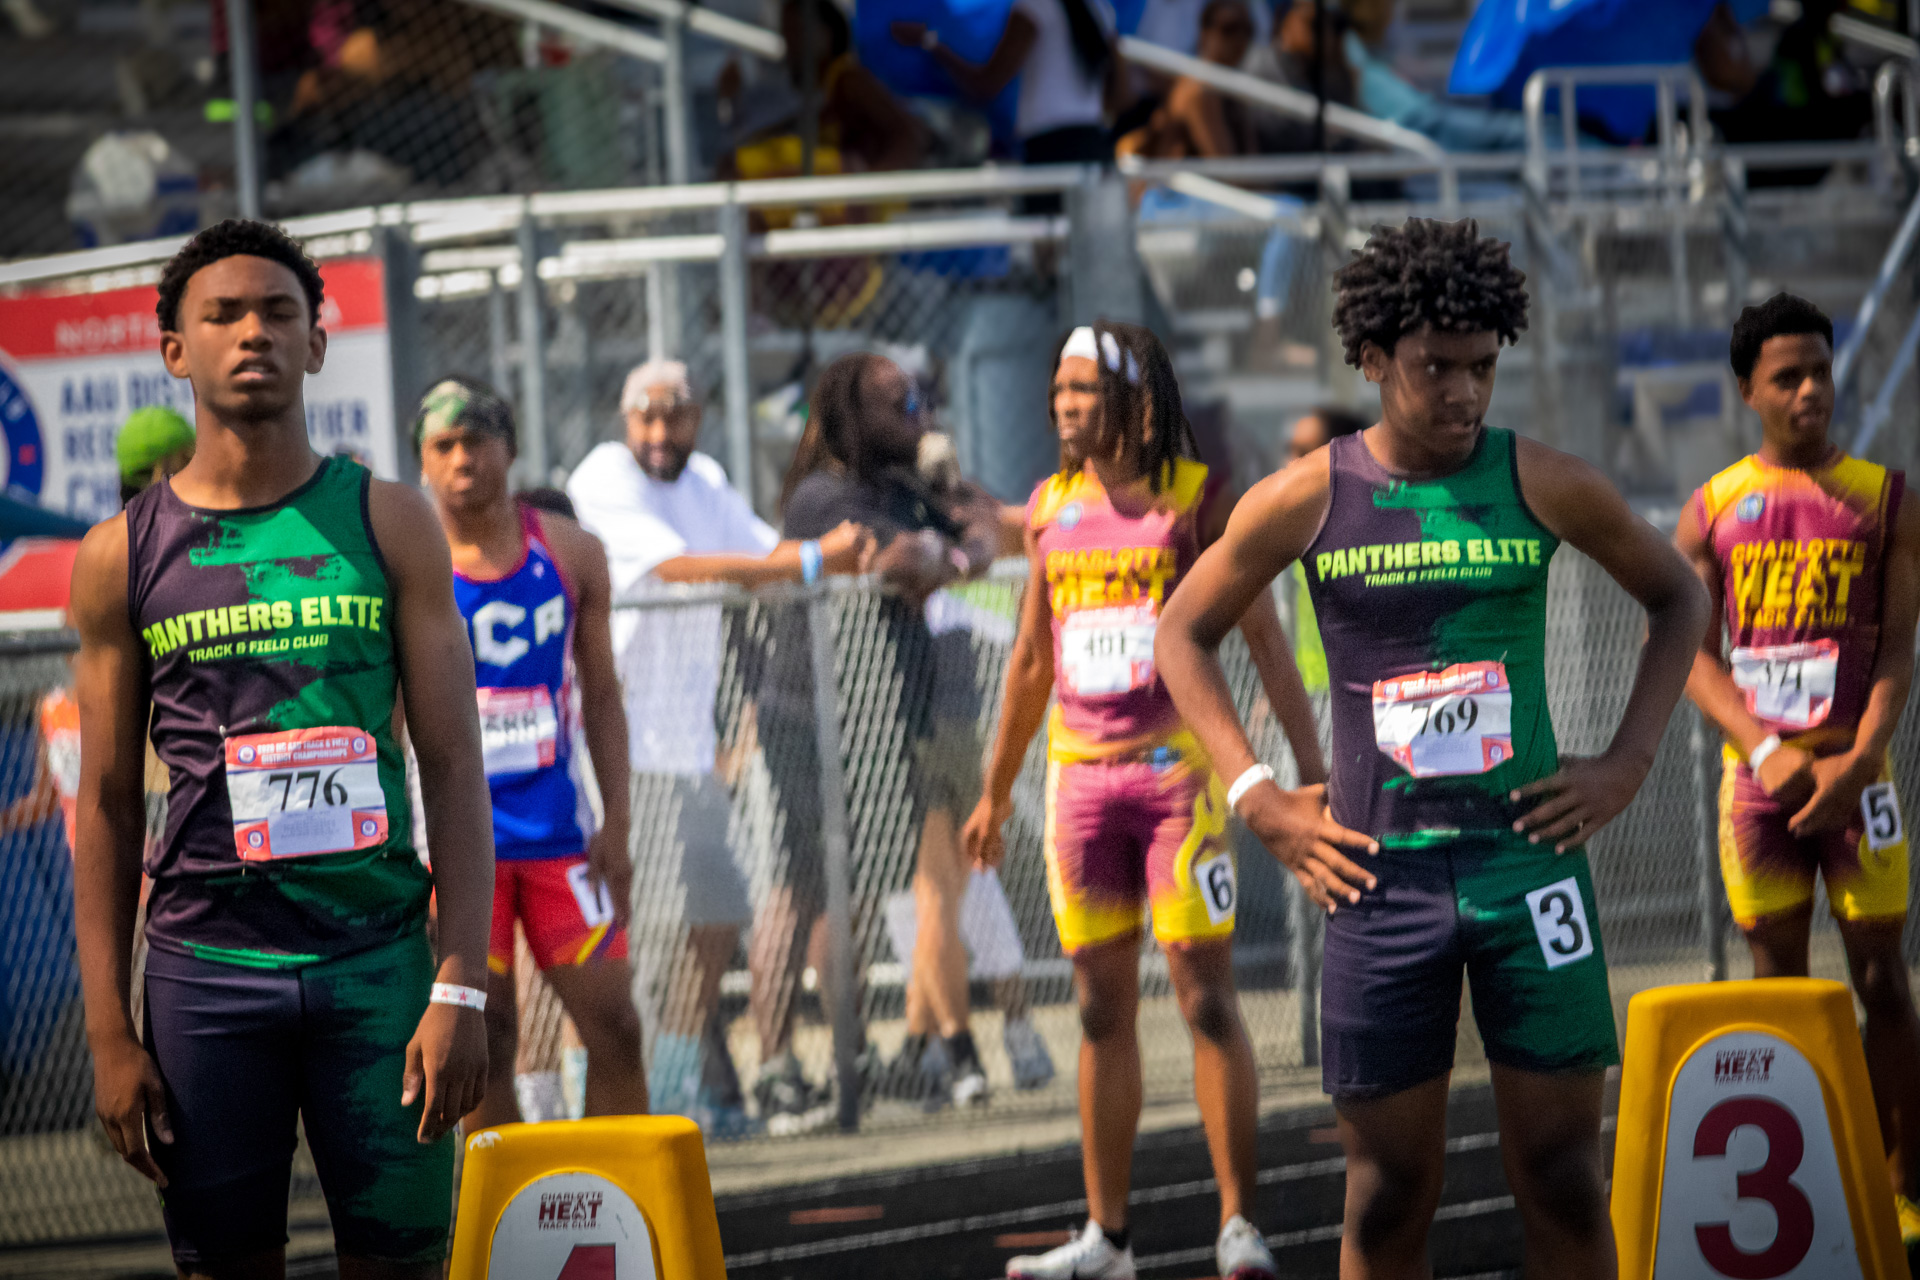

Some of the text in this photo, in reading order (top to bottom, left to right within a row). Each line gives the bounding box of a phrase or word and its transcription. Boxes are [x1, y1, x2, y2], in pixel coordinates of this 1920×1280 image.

[1316, 538, 1541, 582] PANTHERS ELITE
[1364, 571, 1405, 588] TRACK
[1419, 567, 1458, 582] FIELD
[300, 595, 383, 632] ELITE
[187, 643, 233, 663] TRACK
[249, 638, 290, 654] FIELD
[292, 634, 329, 650] CLUB
[1410, 697, 1479, 735] 769
[268, 767, 348, 813] 776
[1868, 787, 1896, 838] 5
[1208, 862, 1232, 912] 6
[1539, 889, 1584, 955] 3
[1716, 1047, 1775, 1059] CHARLOTTE
[541, 1191, 603, 1201] CHARLOTTE
[1693, 1094, 1815, 1280] 3
[538, 1200, 603, 1220] HEAT
[538, 1220, 597, 1231] TRACK CLUB
